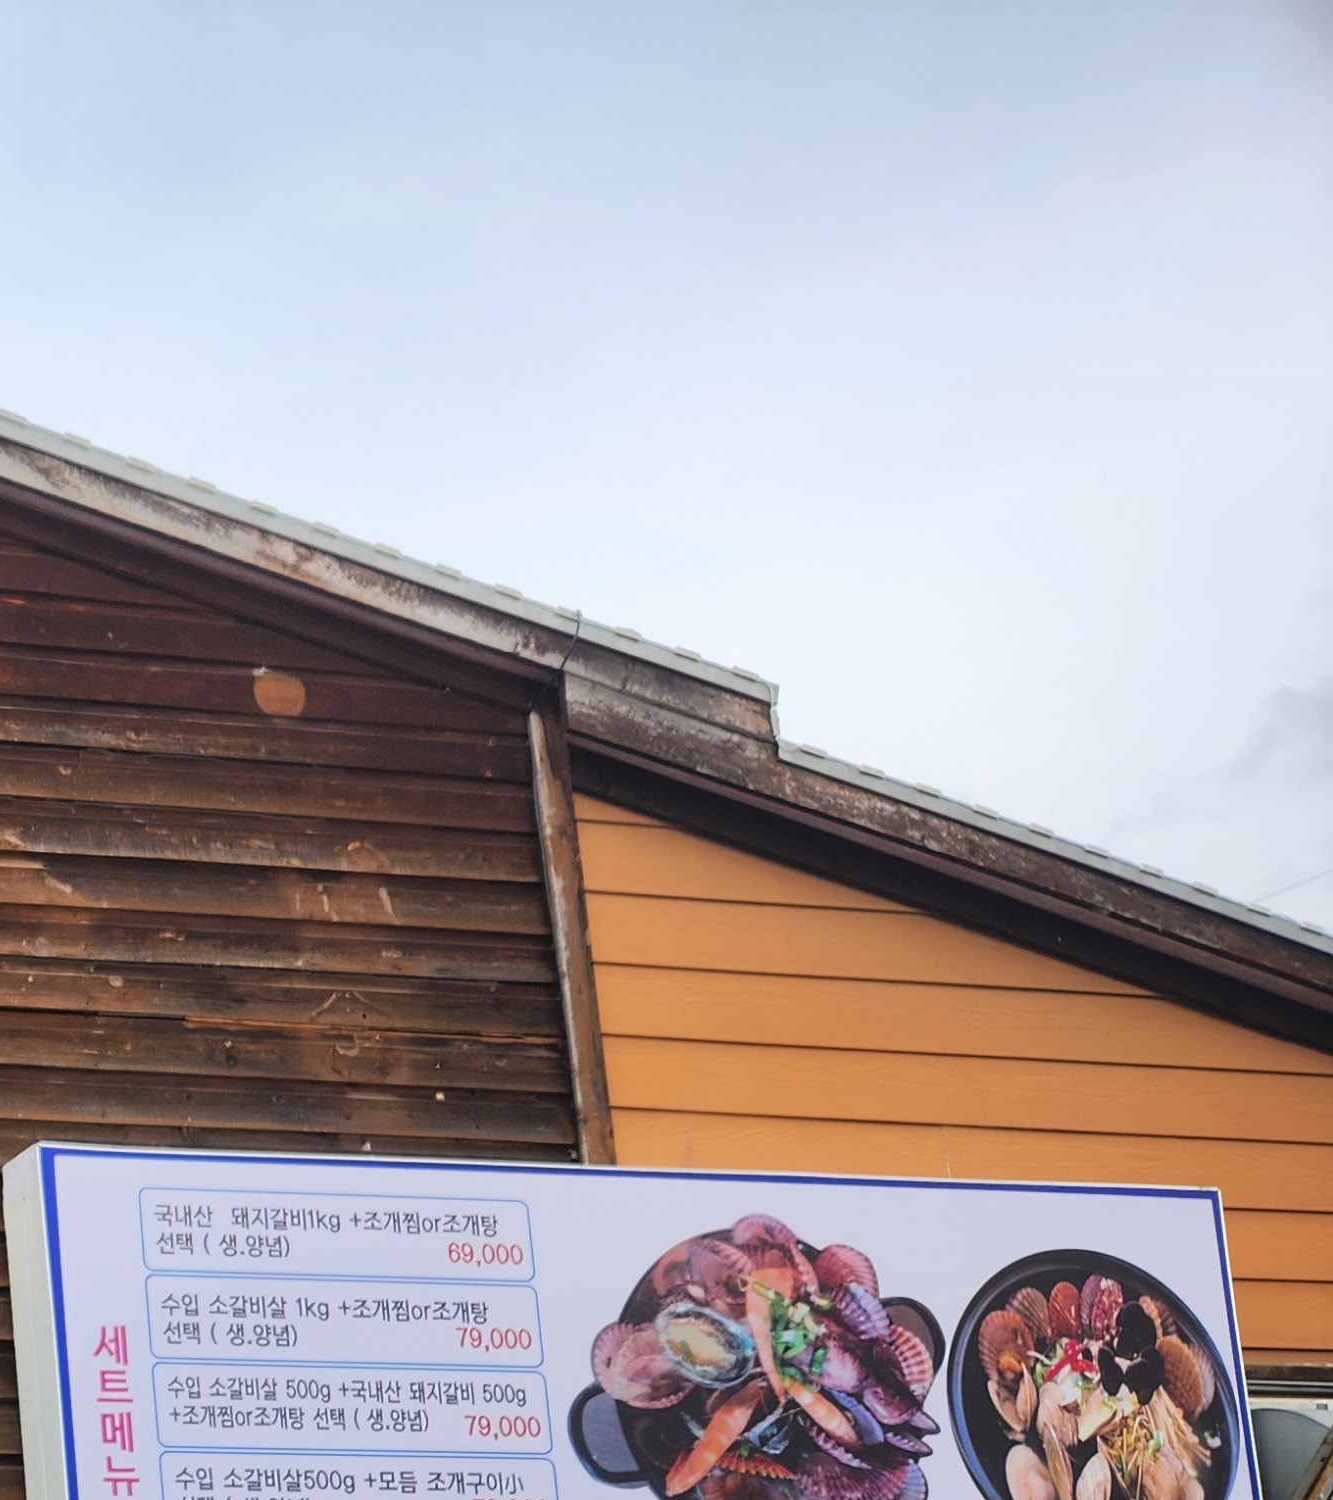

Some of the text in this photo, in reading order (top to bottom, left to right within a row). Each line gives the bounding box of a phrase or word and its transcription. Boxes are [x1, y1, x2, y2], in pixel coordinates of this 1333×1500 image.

[153, 1204, 214, 1229] 국내산
[156, 1232, 194, 1256] 선택
[447, 1242, 524, 1268] 69,000
[161, 1293, 199, 1317] 수입
[208, 1294, 288, 1320] 소갈비살
[295, 1297, 330, 1322] 1kg
[163, 1321, 202, 1346] 선택
[455, 1327, 532, 1353] 79,000
[167, 1375, 202, 1400] 수입
[209, 1376, 278, 1402] 소갈비살
[285, 1378, 331, 1404] 500g
[409, 1380, 476, 1406] 돼지갈비
[482, 1383, 527, 1408] 500g
[93, 1325, 140, 1497] 세트메뉴
[312, 1407, 346, 1432] 선택
[464, 1415, 542, 1441] 79,000
[174, 1467, 214, 1491] 수입
